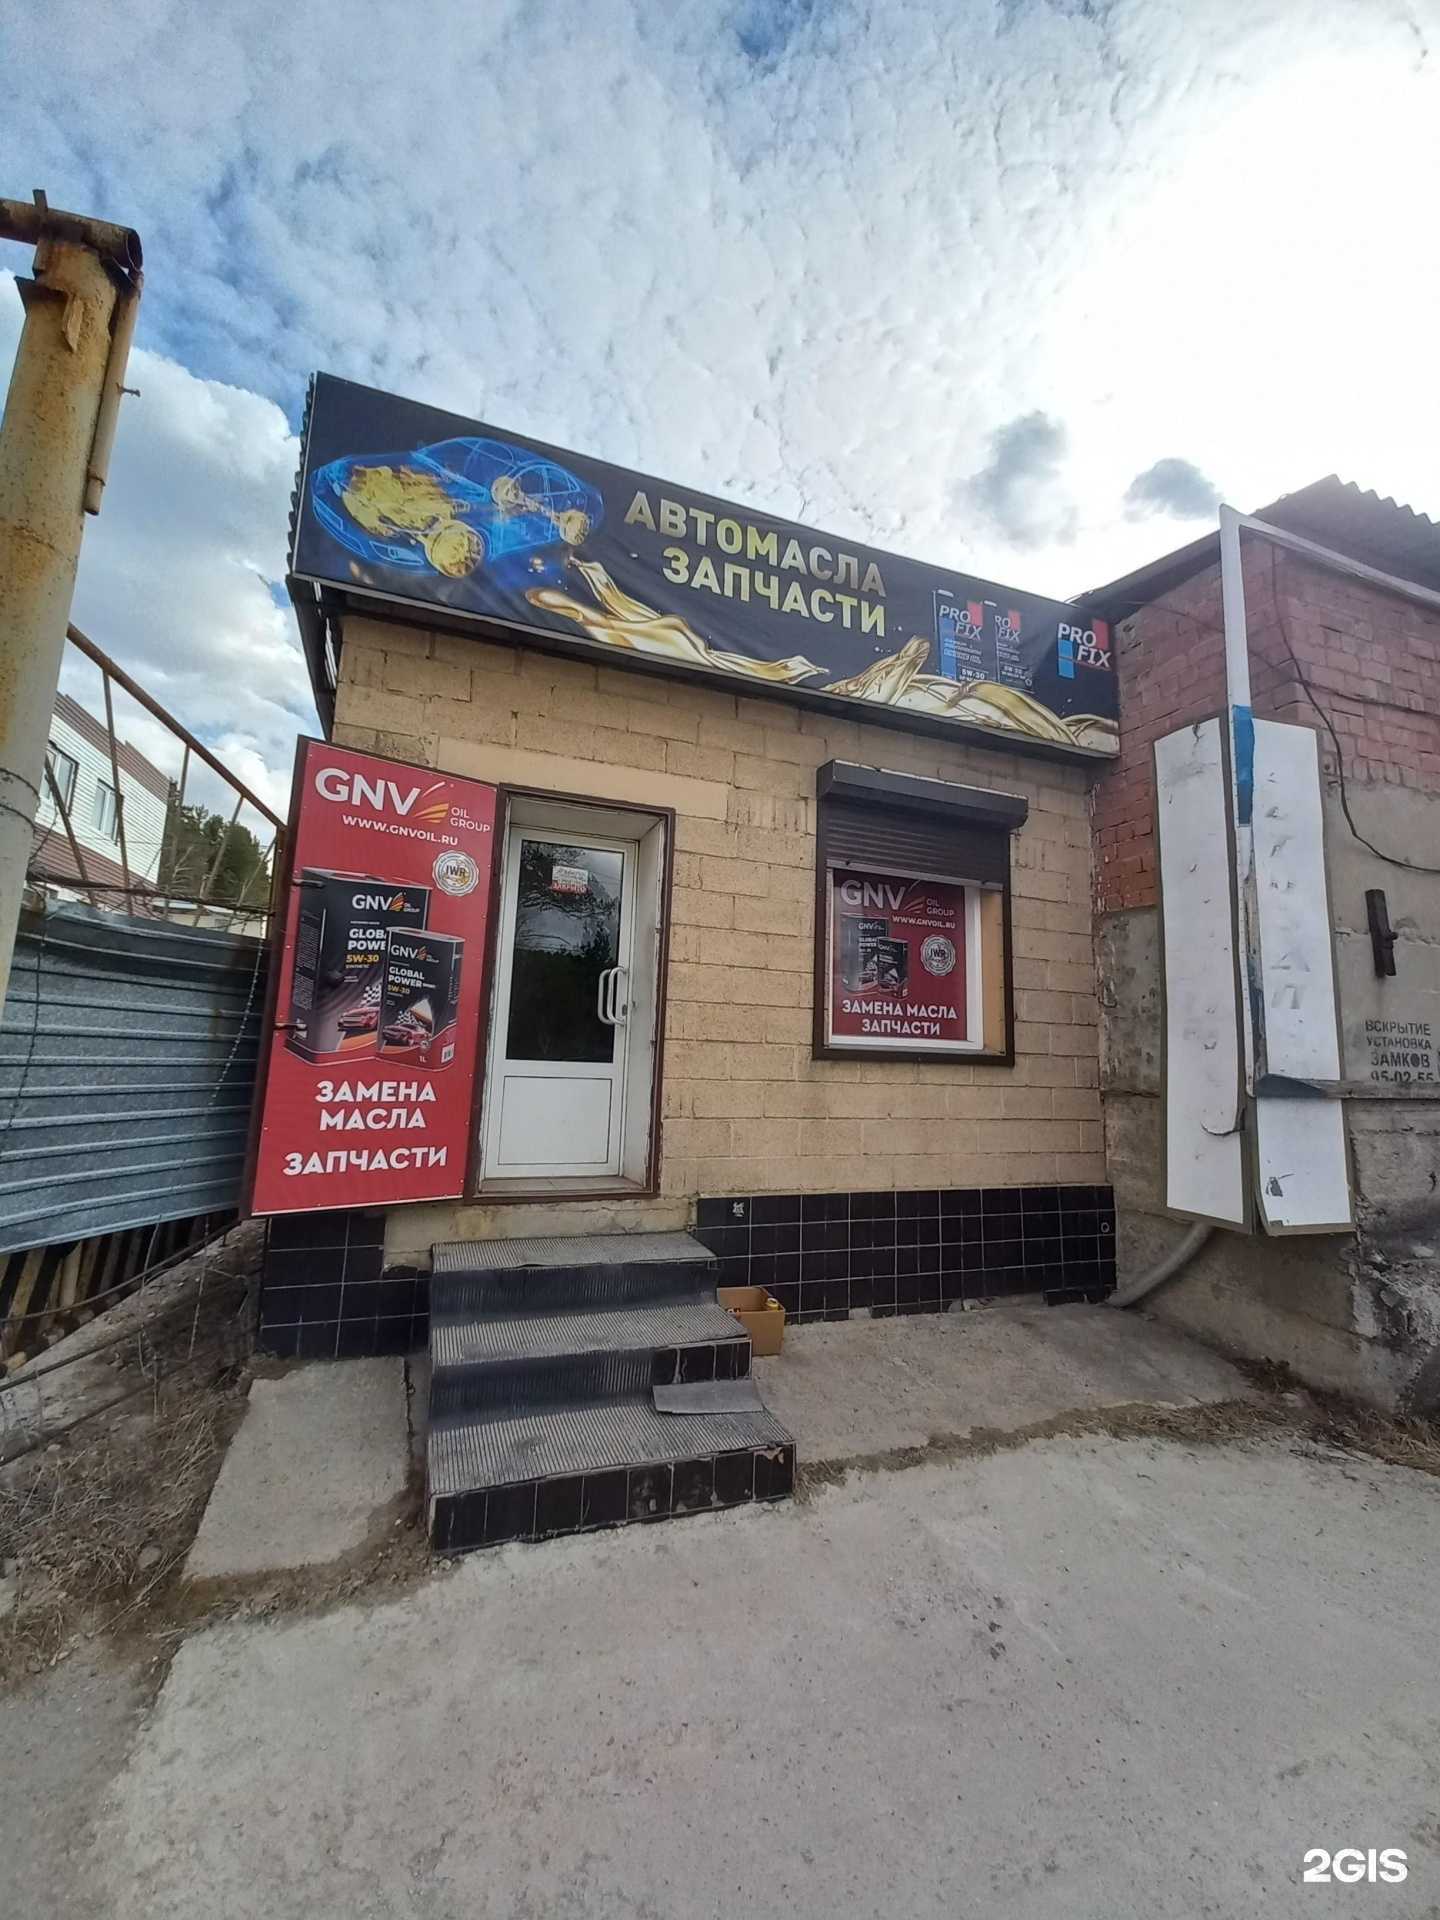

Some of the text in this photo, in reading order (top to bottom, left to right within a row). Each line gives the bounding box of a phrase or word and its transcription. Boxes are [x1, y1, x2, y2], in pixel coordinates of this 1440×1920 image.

[624, 490, 886, 597] АВТОМАСЛА
[662, 547, 885, 637] ЗАПЧАСТИ
[940, 605, 971, 623] PRO
[994, 615, 1011, 629] RO
[955, 621, 982, 640] FIX
[999, 627, 1020, 643] FIX
[1057, 622, 1097, 648] PRO
[1077, 645, 1112, 668] FIX
[315, 768, 421, 816] GNV
[451, 807, 469, 818] OIL
[342, 815, 458, 846] WWW.GNVOIL.RU
[450, 817, 490, 833] GROUP
[352, 894, 393, 911] GNV
[840, 879, 906, 911] GNV
[926, 906, 955, 917] GROUP
[349, 928, 387, 939] GLOB
[347, 940, 386, 951] POWE
[391, 944, 418, 959] GNV
[346, 954, 379, 963] 5W-30
[388, 974, 422, 987] POWER
[389, 966, 424, 980] GLOBAL
[842, 999, 958, 1020] ЗАМЕНА МАСЛА
[862, 1019, 940, 1036] ЗАПЧАСТИ
[1365, 1019, 1432, 1037] ВСКРЫТИЕ
[1366, 1036, 1432, 1050] УСТАНОВКА
[1370, 1050, 1430, 1068] ЗАМКОВ
[315, 1081, 437, 1102] ЗАМЕНА
[319, 1107, 426, 1131] МАСЛА
[283, 1146, 447, 1176] ЗАПЧАСТИ
